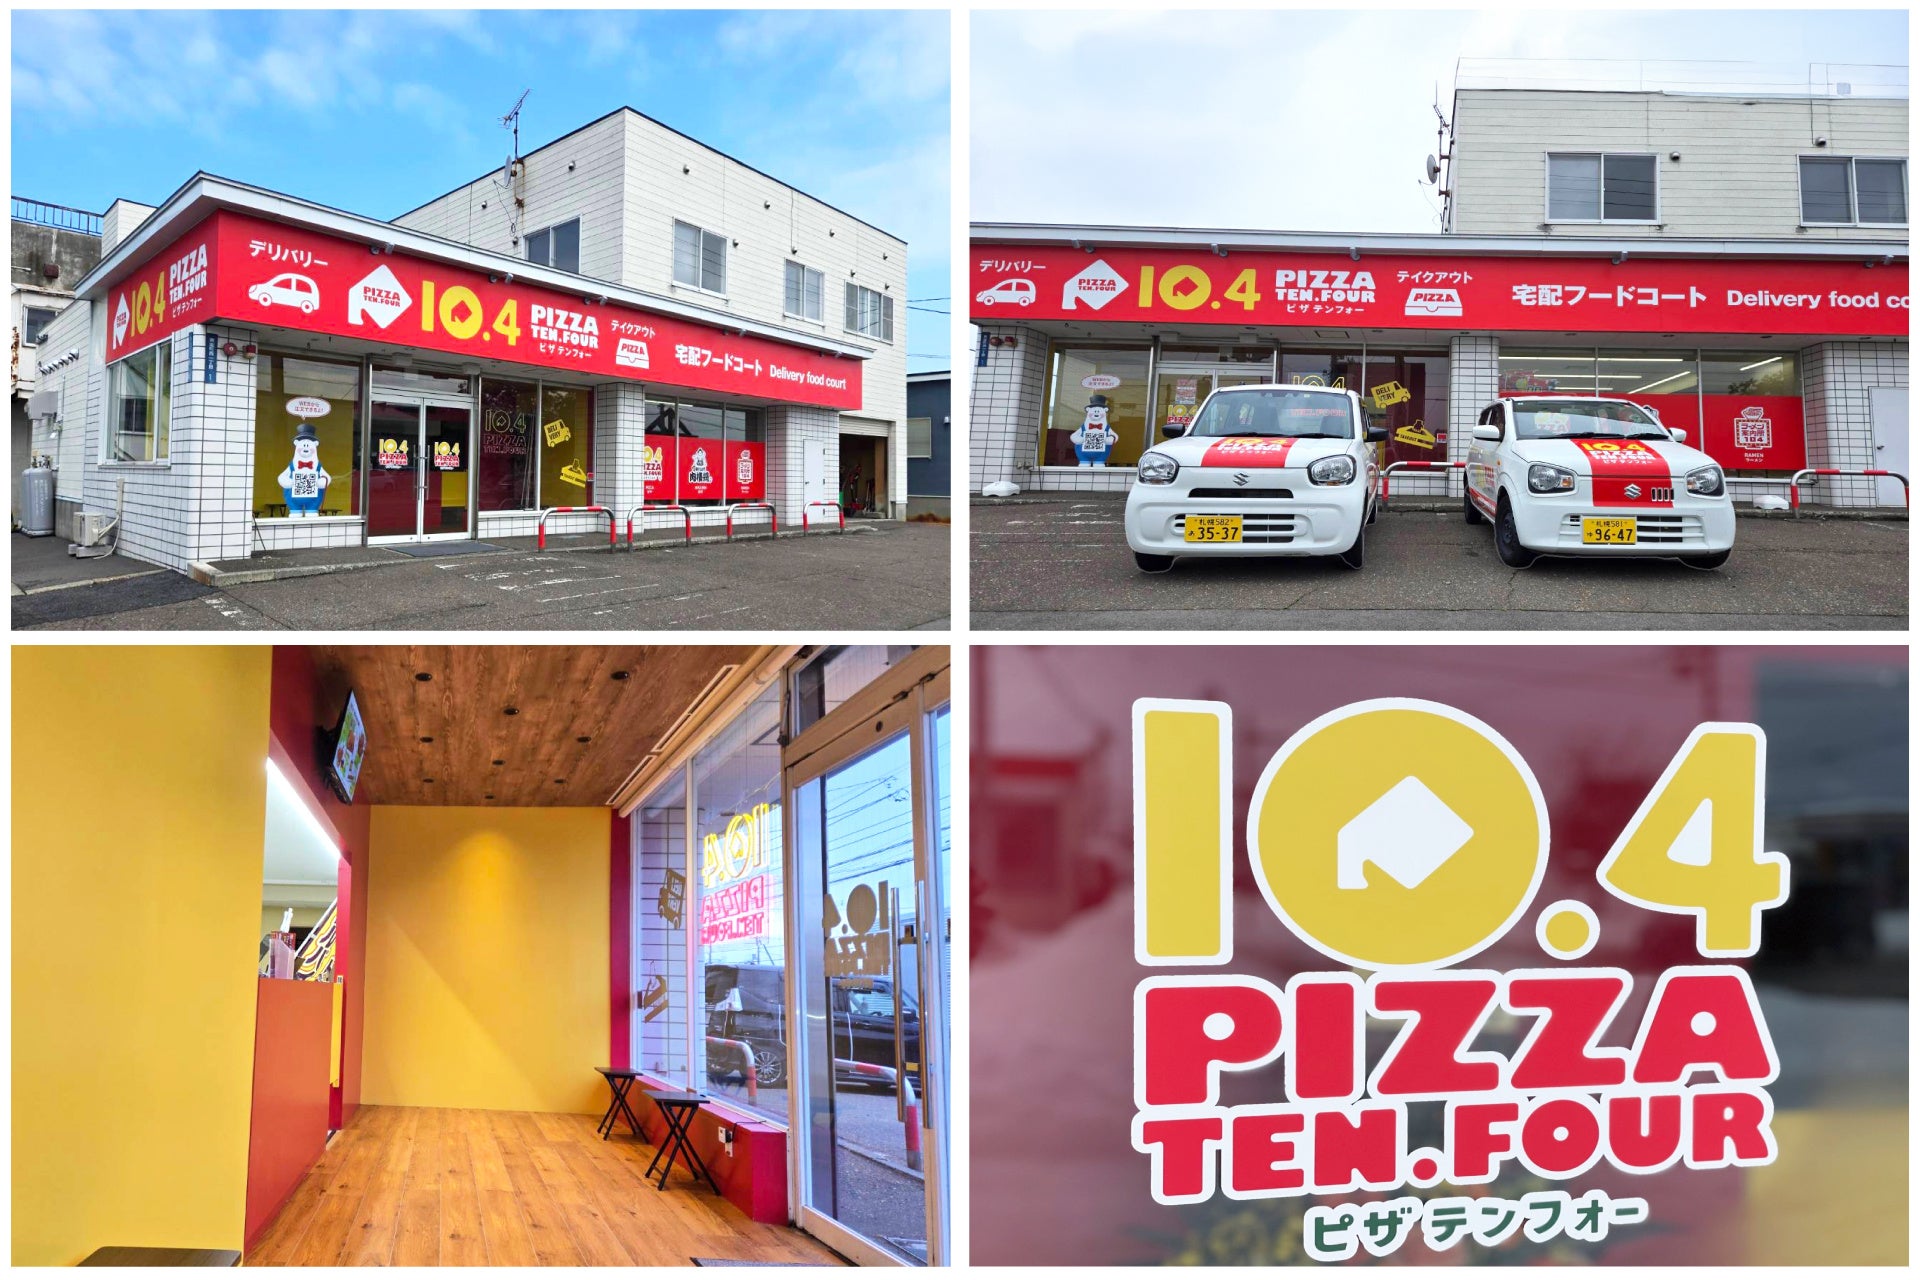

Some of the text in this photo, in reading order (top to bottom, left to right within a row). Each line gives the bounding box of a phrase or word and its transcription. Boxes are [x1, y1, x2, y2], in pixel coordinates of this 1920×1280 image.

[249, 239, 328, 268] デリバリー
[170, 243, 208, 288] PIZZA
[979, 260, 1046, 273] デリバリー
[169, 270, 207, 304] TEN.FOUR
[1078, 278, 1117, 287] PIZZA
[1138, 264, 1261, 311] 10.4
[1275, 269, 1376, 289] PIZZA
[1396, 271, 1473, 284] テイクアウト
[363, 286, 400, 300] PIZZA
[363, 294, 401, 307] TEN.FOUR
[1275, 288, 1376, 303] TEN.FOUR
[1413, 292, 1455, 303] PIZZA
[1511, 283, 1707, 308] 宅配フードコート
[1727, 289, 1820, 309] Delivery
[1828, 290, 1880, 308] food
[421, 280, 521, 346] 10.4
[530, 303, 599, 335] PIZZA
[530, 324, 599, 349] TEN.FOUR
[610, 319, 656, 339] テイクアウト
[620, 343, 646, 356] PIZZA
[674, 343, 763, 377] 宅配フードコート
[769, 364, 847, 390] Delivery food court
[1375, 386, 1391, 396] DELI
[1197, 526, 1239, 540] 35-37
[1595, 528, 1633, 541] 96-47
[1133, 697, 1790, 971] 10.4
[1136, 966, 1780, 1108] PIZZA
[1132, 1085, 1777, 1204] TEN.FOUR
